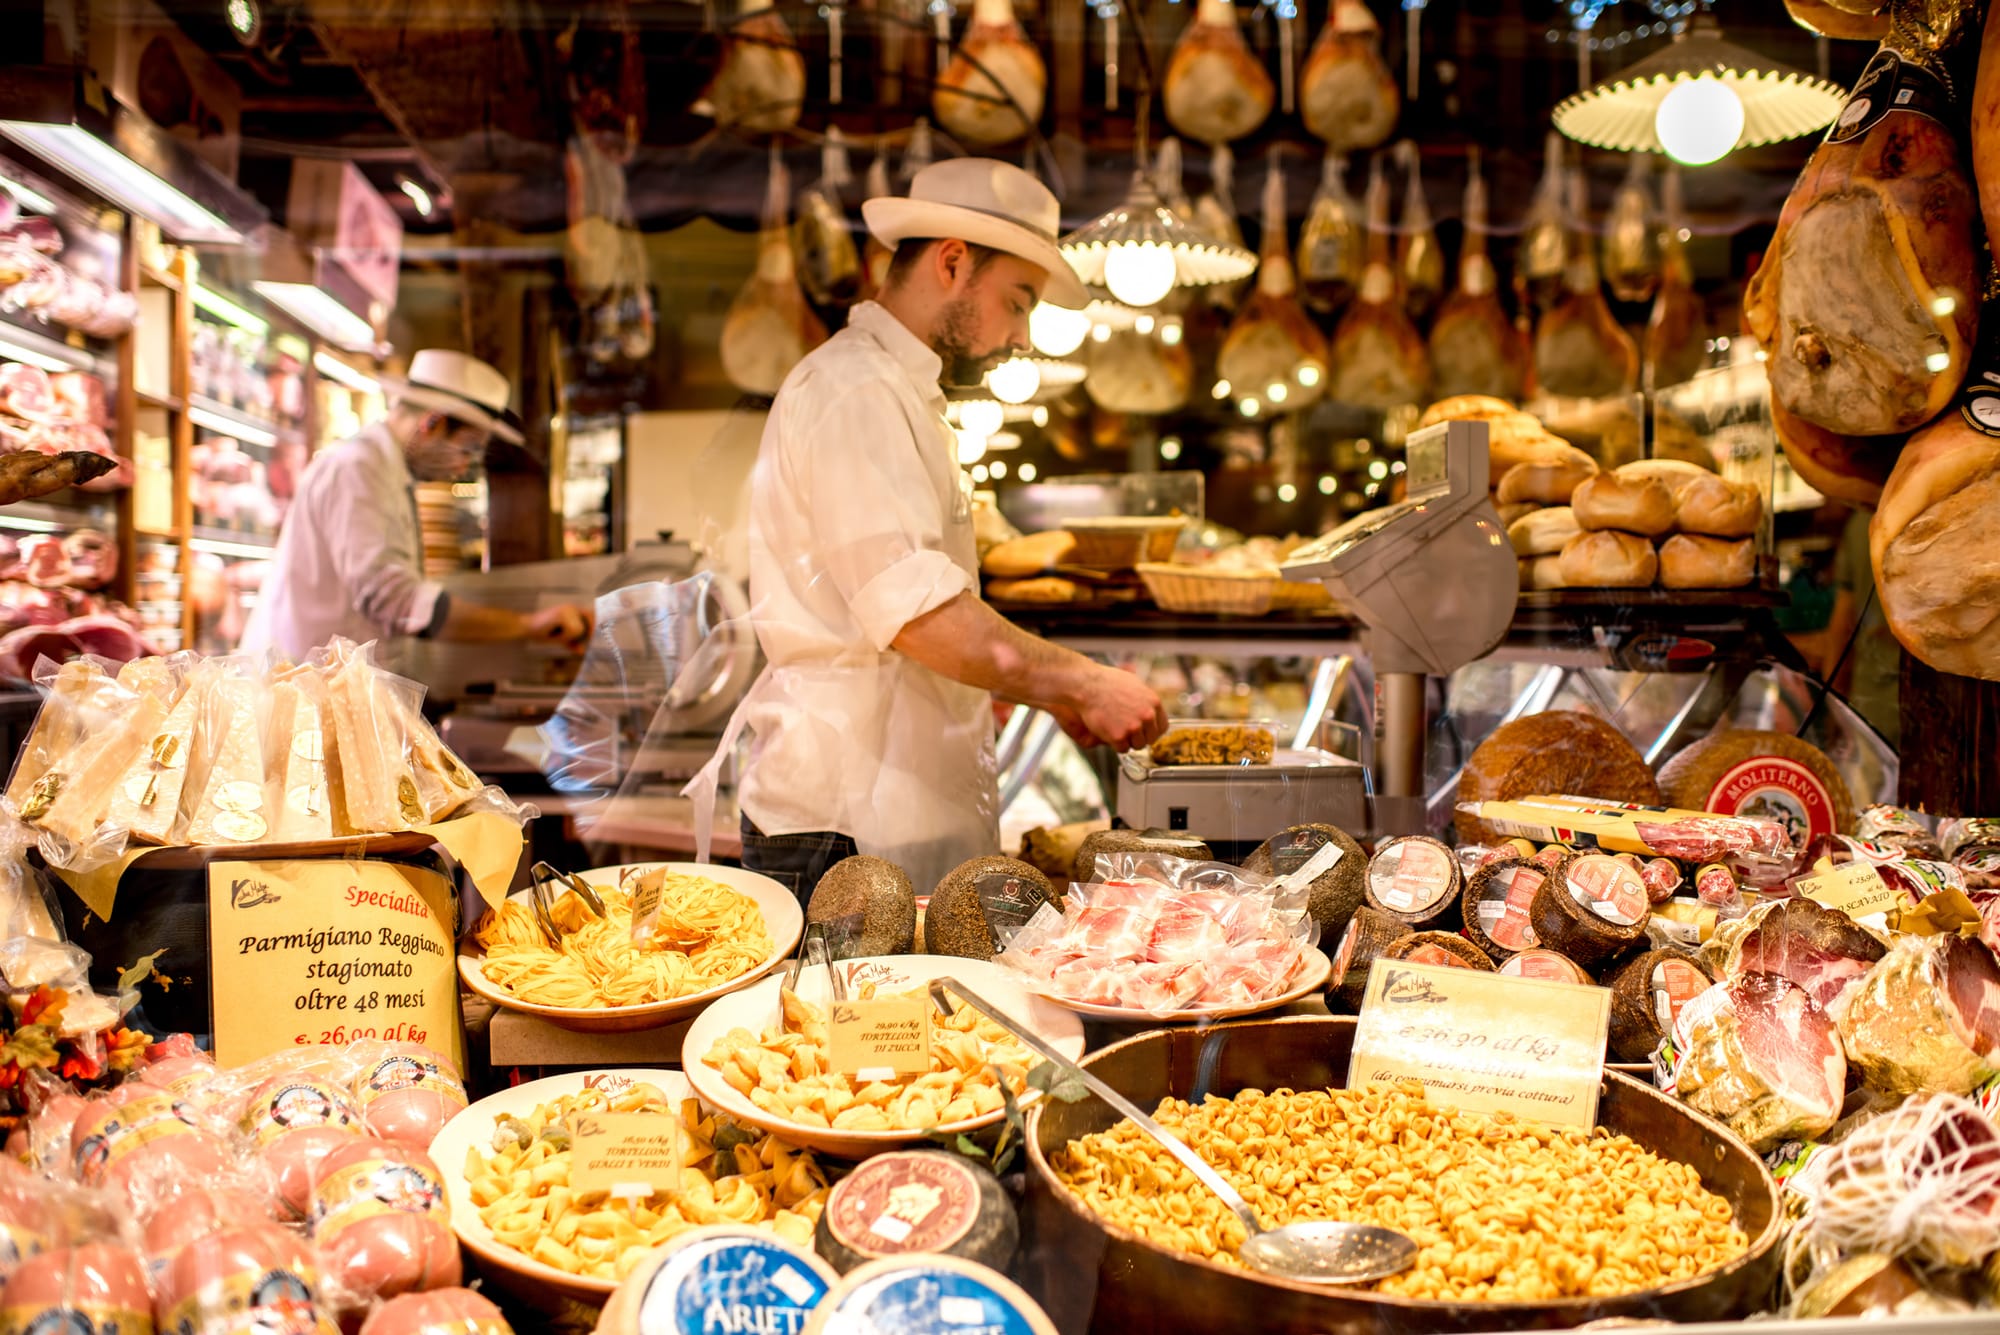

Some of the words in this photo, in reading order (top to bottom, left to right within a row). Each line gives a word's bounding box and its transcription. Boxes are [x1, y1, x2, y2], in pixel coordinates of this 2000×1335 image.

[1727, 767, 1818, 806] MOLITERNO
[344, 884, 430, 919] Specialità
[1846, 891, 1890, 912] SCAVATO
[239, 926, 372, 955] Parmigiano
[378, 928, 444, 957] Reggiano
[306, 958, 413, 984] stagionato
[295, 988, 347, 1010] oltre
[354, 991, 379, 1013] 48
[385, 989, 426, 1010] mesi
[383, 1022, 404, 1042] al
[408, 1024, 427, 1044] kg
[860, 1032, 920, 1041] TORTELLONI
[874, 1044, 887, 1053] DI
[889, 1043, 920, 1052] ZUCCA
[1526, 1036, 1560, 1062] kg
[1468, 1083, 1516, 1098] previa
[1518, 1088, 1575, 1106] cottura)
[606, 1147, 670, 1156] TORTELLONI
[588, 1160, 625, 1170] GIALLI
[627, 1160, 635, 1168] E
[639, 1160, 671, 1168] VERDI
